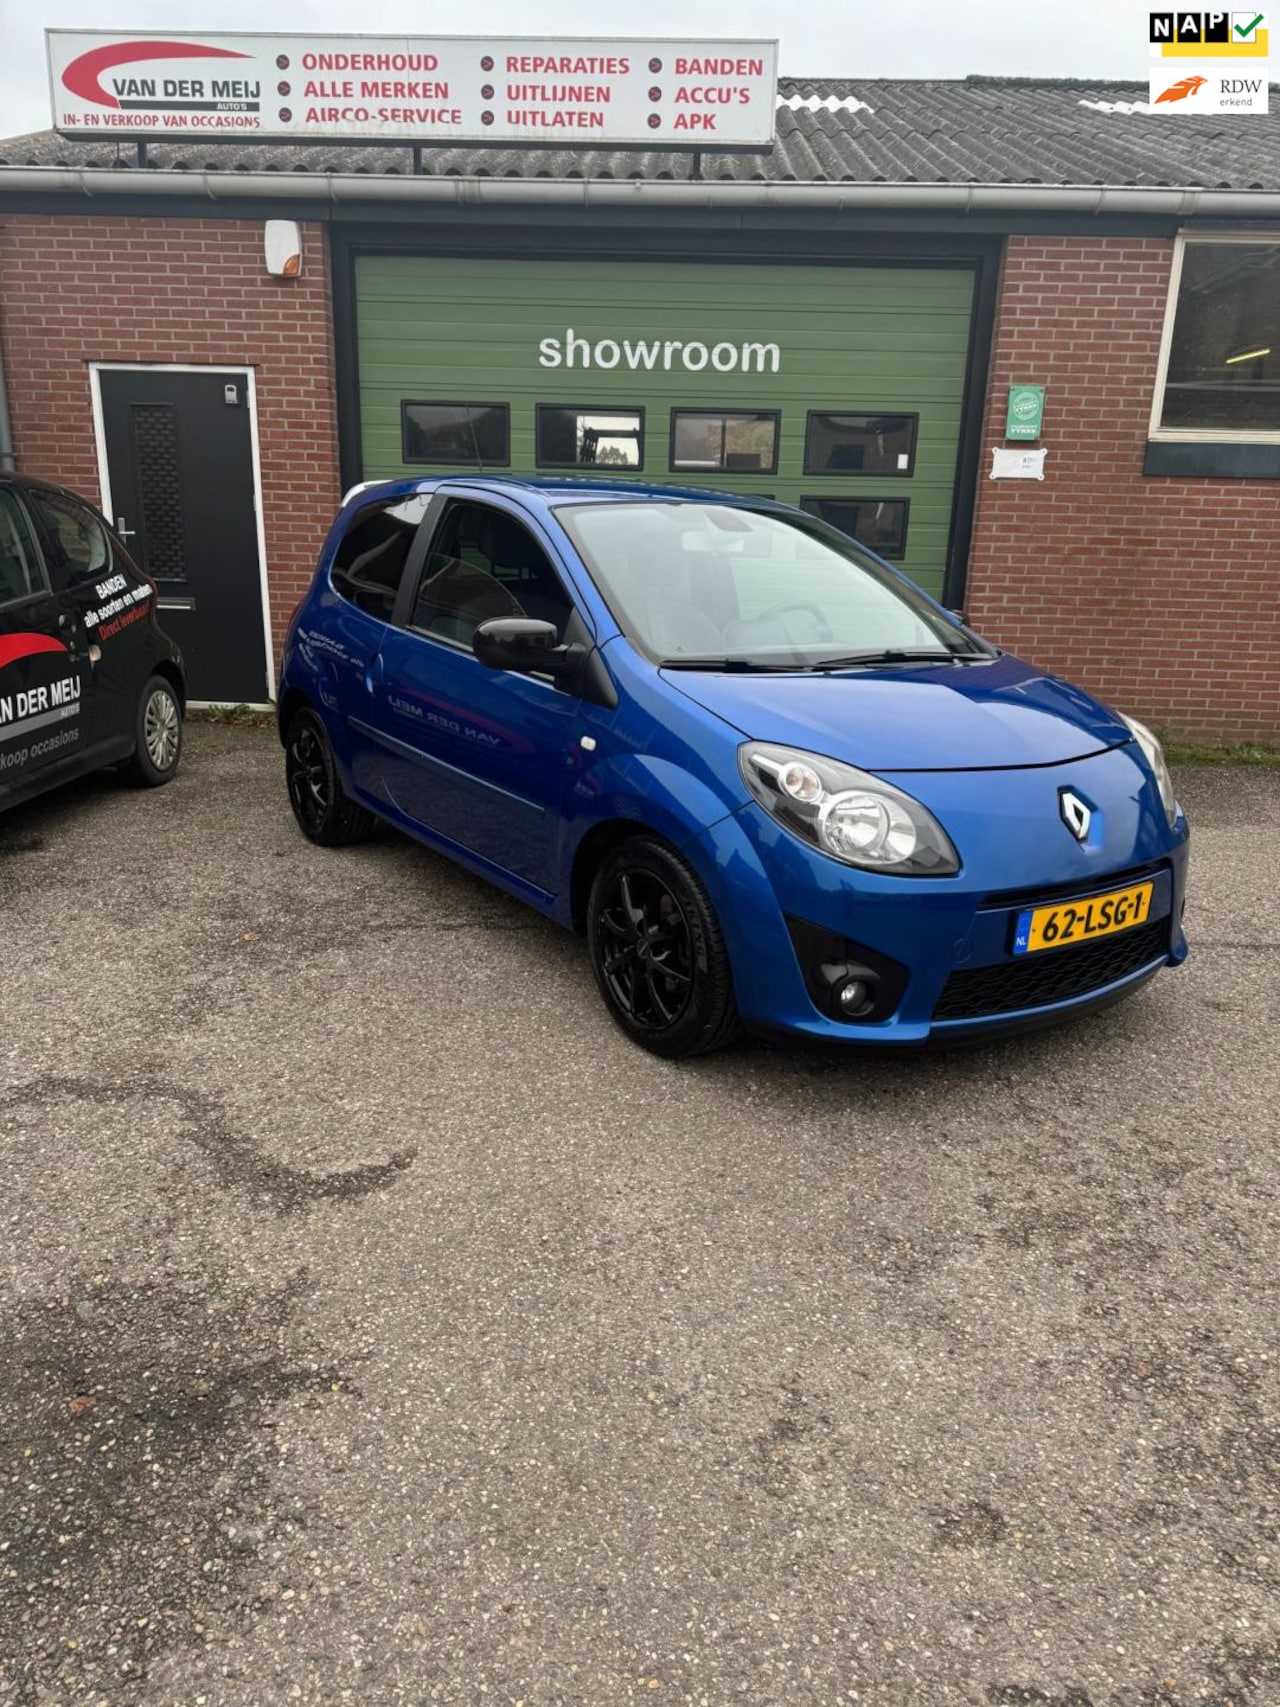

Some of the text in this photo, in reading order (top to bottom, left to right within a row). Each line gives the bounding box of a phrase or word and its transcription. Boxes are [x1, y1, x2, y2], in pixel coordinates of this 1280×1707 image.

[302, 53, 438, 71] ONDERHOUD
[506, 56, 630, 75] REPARATIES
[675, 58, 764, 76] BANDEN
[112, 78, 261, 99] VAN DER MEIJ
[304, 81, 449, 99] ALLE MERKEN
[507, 84, 611, 103] UITLIJNEN
[674, 87, 751, 105] ACCU'S
[63, 113, 261, 129] IN- EN VERKOOP VAN OCCASIONS
[305, 107, 462, 124] AIRCO-SERVICE
[507, 110, 604, 128] UITLATEN
[673, 113, 717, 130] APK
[538, 328, 782, 375] showroom
[95, 573, 127, 600] BANDEN
[16, 686, 49, 718] DER
[50, 675, 81, 706] MEIJ
[31, 728, 79, 758] occasions
[1043, 892, 1143, 942] 62-LSG-1
[1016, 937, 1026, 946] NL
